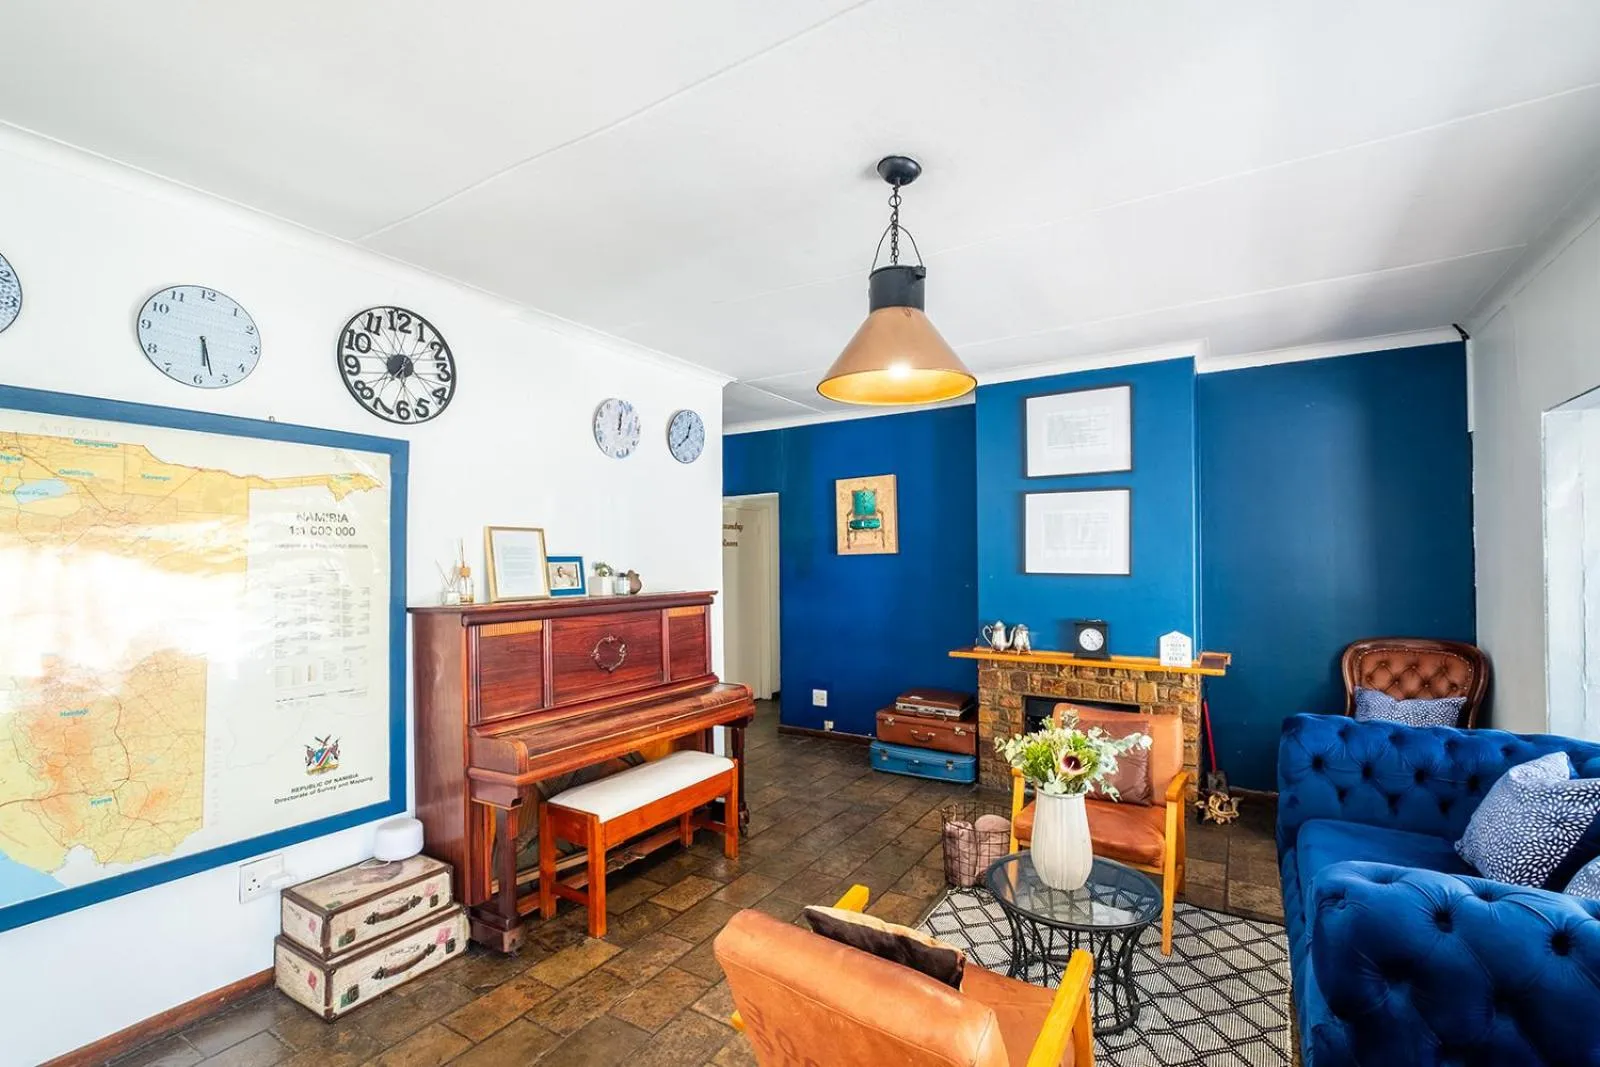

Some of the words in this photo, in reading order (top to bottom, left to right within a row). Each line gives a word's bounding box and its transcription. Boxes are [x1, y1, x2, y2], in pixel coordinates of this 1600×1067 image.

[172, 290, 184, 303] 11
[201, 290, 216, 302] 12
[153, 302, 169, 314] 10
[233, 308, 238, 317] 1
[141, 319, 152, 329] 9
[245, 325, 254, 335] 2
[364, 312, 382, 336] 11
[388, 310, 412, 334] 12
[345, 329, 372, 354] 10
[417, 322, 425, 343] 1
[147, 343, 157, 354] 8
[250, 345, 258, 355] 3
[430, 341, 446, 361] 2
[164, 362, 172, 372] 7
[344, 354, 361, 376] 9
[436, 362, 451, 382] 3
[193, 374, 203, 384] 6
[220, 373, 229, 384] 5
[354, 380, 374, 400] 8
[432, 387, 447, 405] 4
[373, 397, 394, 415] 7
[396, 400, 411, 420] 6
[415, 398, 430, 418] 5
[335, 526, 356, 537] 000
[274, 791, 308, 805] Directorate
[309, 788, 316, 796] of
[317, 784, 337, 794] Survey
[349, 776, 374, 786] Mapping
[290, 781, 323, 793] REPUBLIC
[334, 773, 359, 783] NAMIBIA
